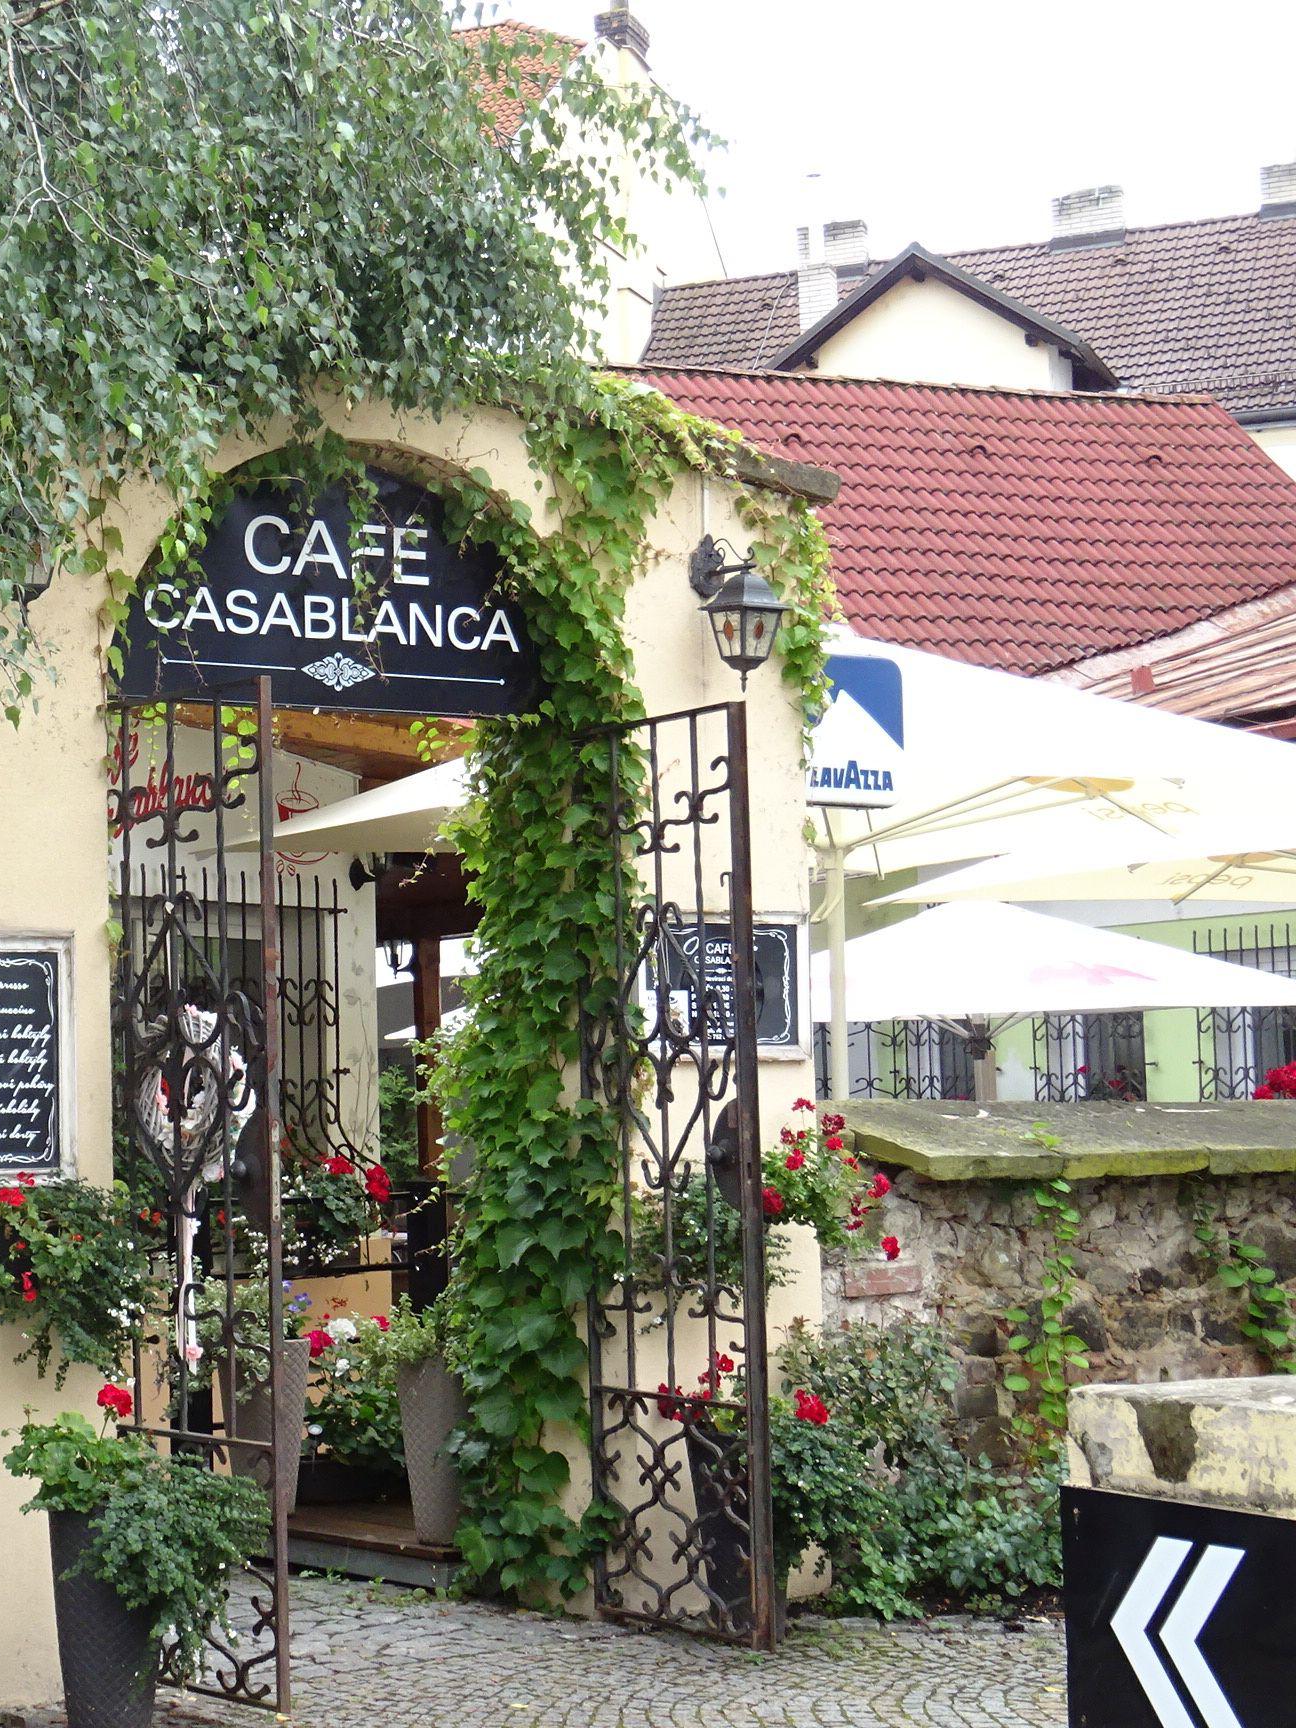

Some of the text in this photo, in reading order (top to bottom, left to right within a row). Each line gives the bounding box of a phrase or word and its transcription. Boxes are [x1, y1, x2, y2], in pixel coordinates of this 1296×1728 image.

[143, 583, 520, 653] CASABLANCA
[810, 760, 894, 791] LAVAZZA
[10, 1023, 52, 1047] koktejly
[7, 1048, 48, 1072] koktejly
[8, 1123, 41, 1147] dorty
